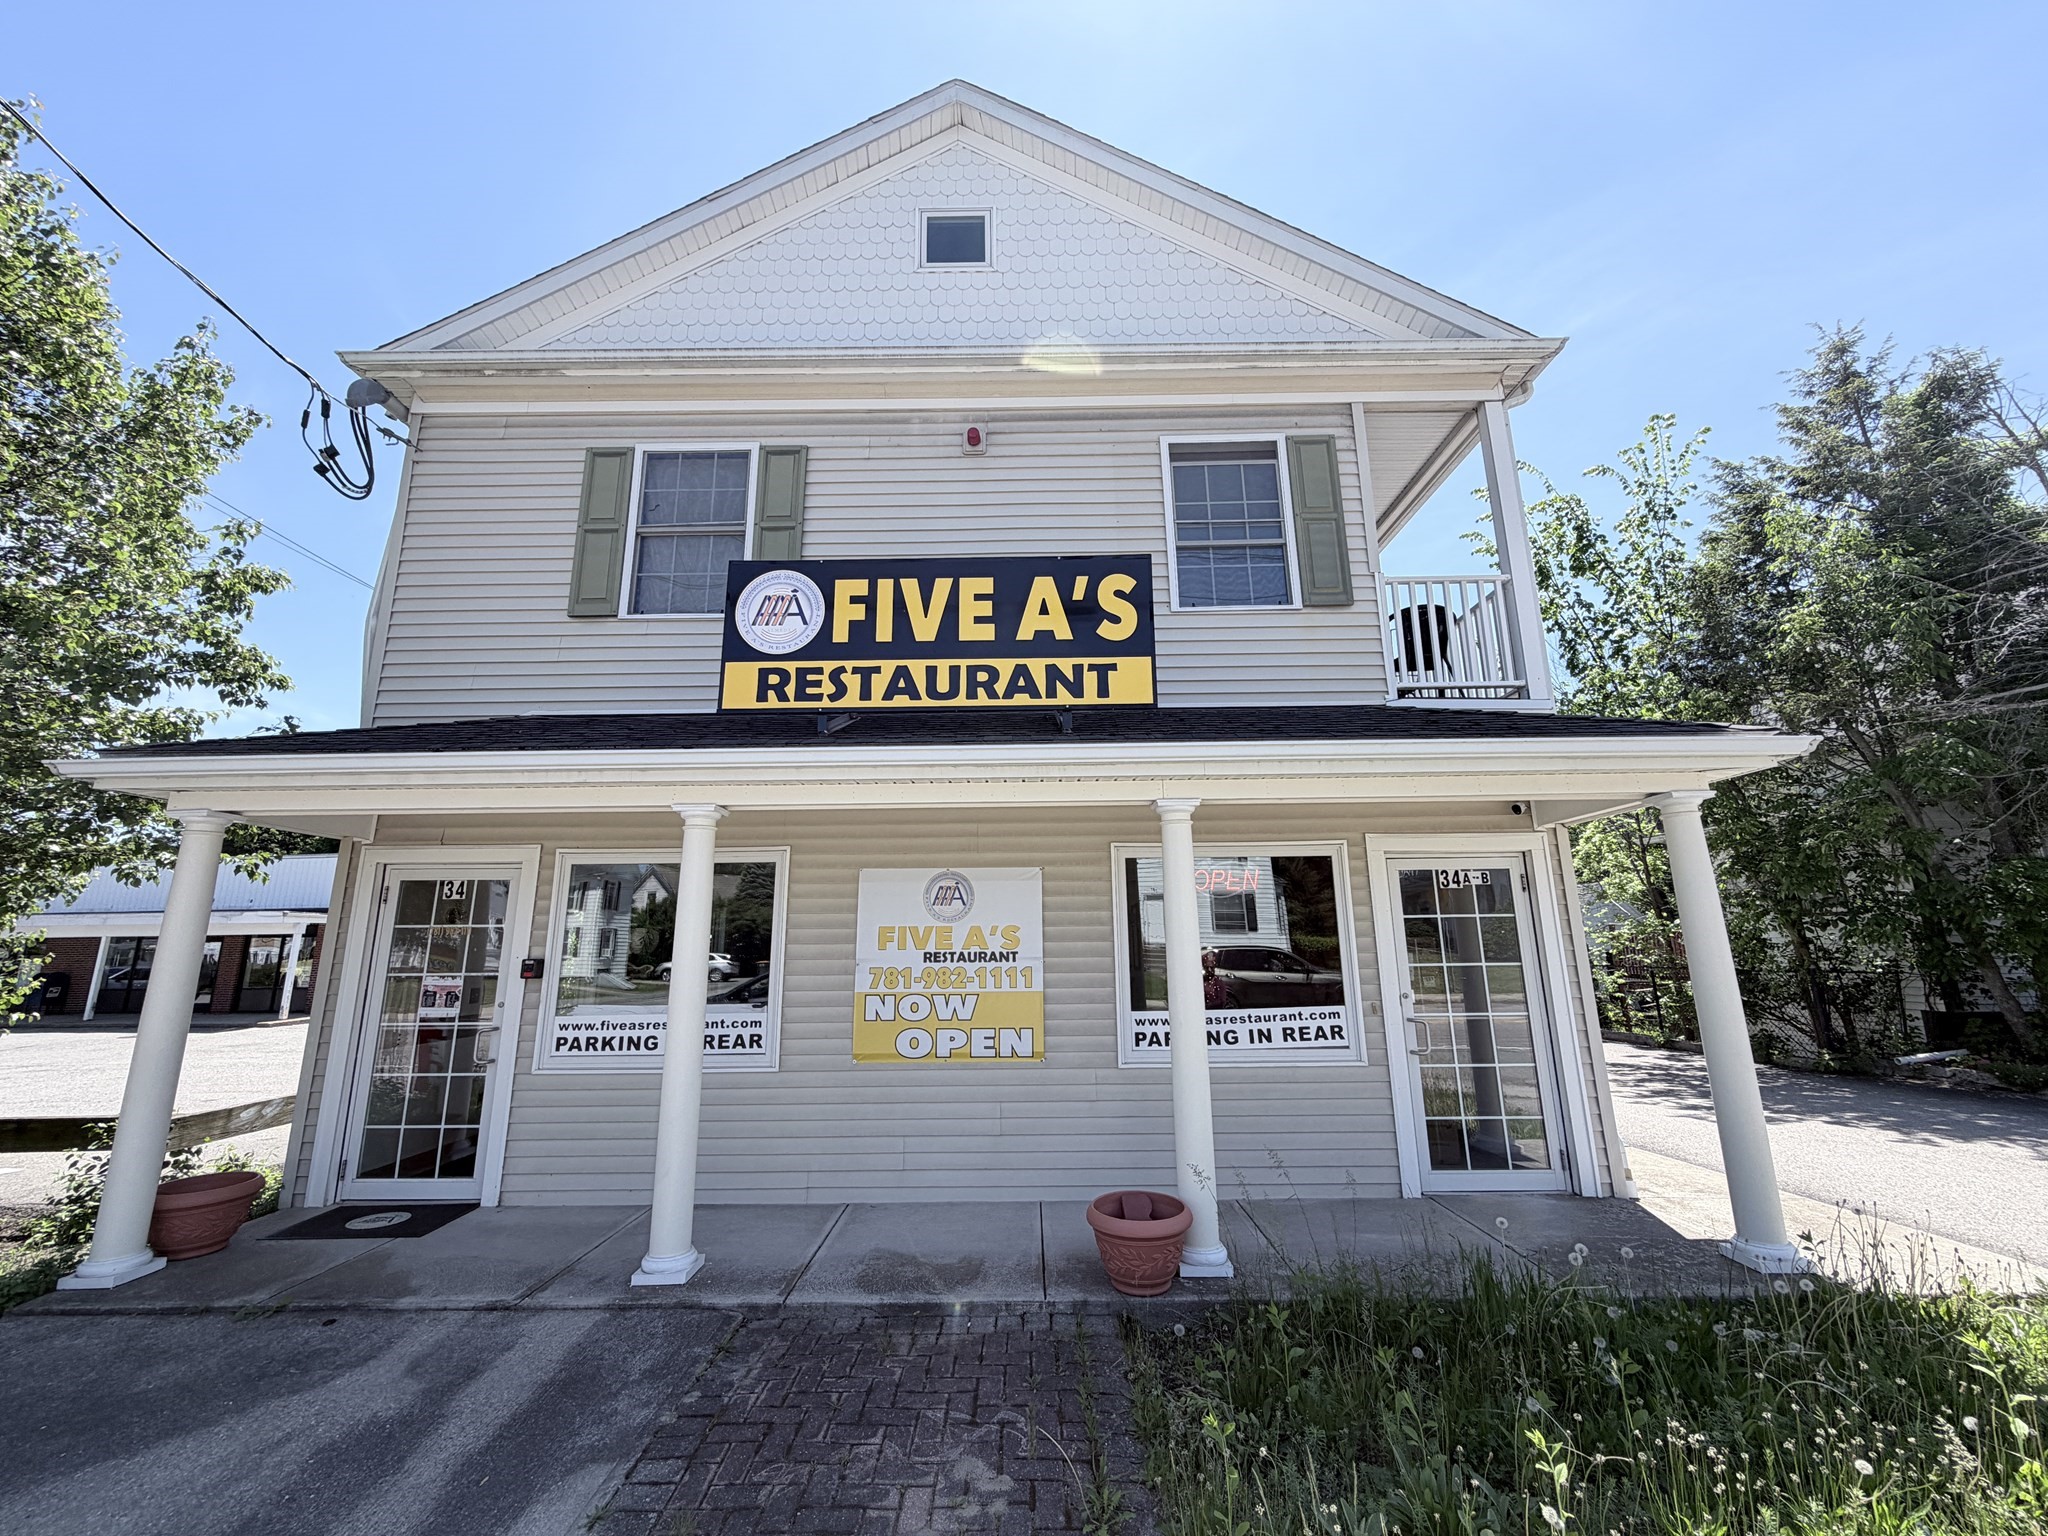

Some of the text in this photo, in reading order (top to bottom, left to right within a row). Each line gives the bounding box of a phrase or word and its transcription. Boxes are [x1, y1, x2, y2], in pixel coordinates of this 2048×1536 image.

[832, 573, 1139, 643] FIVE A'S
[756, 663, 1118, 703] RESTAURANT
[444, 880, 465, 899] 34
[1194, 869, 1259, 891] OPEN
[878, 924, 1021, 951] FIVE A'S
[923, 951, 1019, 963] RESTAURANT
[869, 966, 1033, 989] 781-982-1111
[864, 993, 980, 1021] NOW
[558, 1018, 762, 1032] www.fiveasresant.com
[1134, 1011, 1341, 1027] wwwasrestaurant.com
[555, 1035, 659, 1052] PARKING
[703, 1033, 764, 1050] REAR
[894, 1027, 1034, 1059] OPEN
[1134, 1024, 1345, 1047] PANG IN REAR
